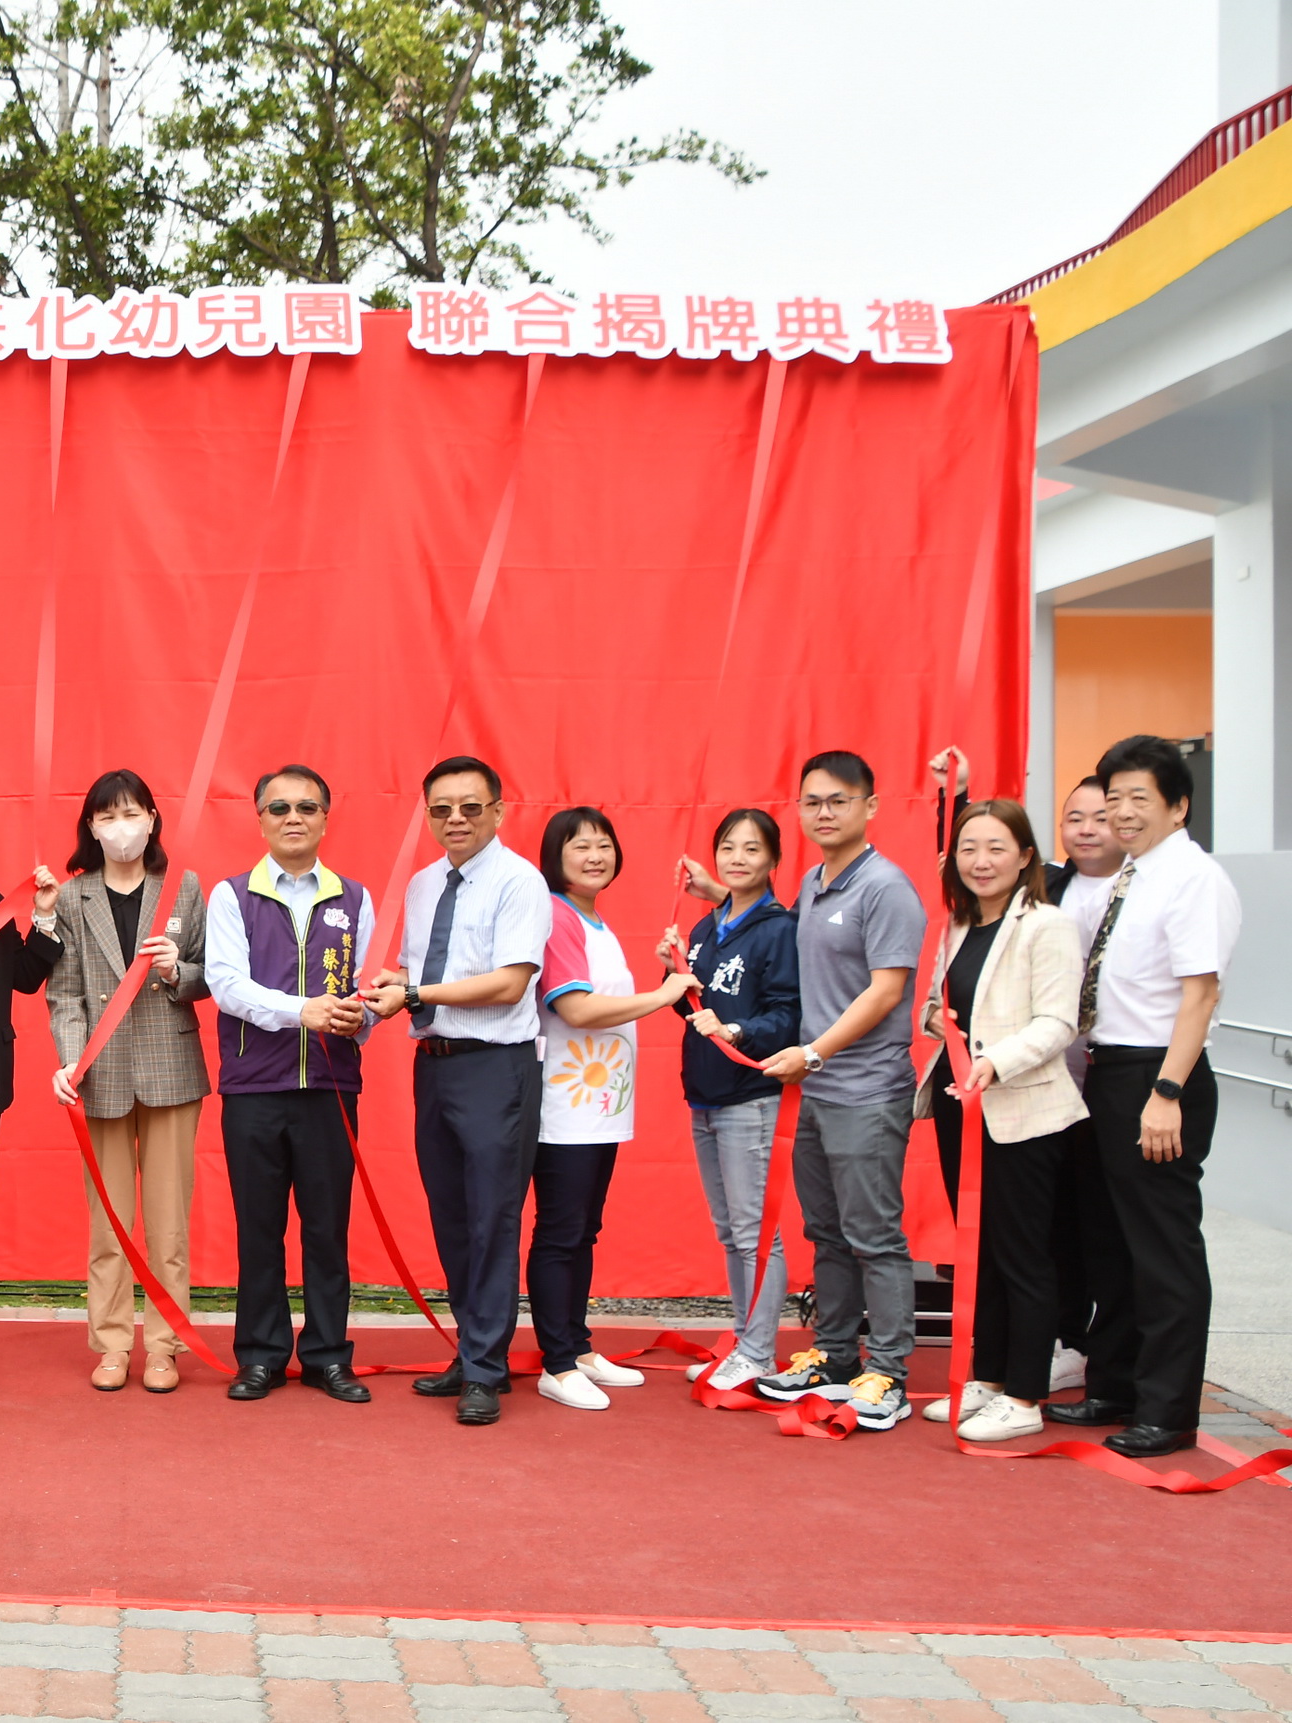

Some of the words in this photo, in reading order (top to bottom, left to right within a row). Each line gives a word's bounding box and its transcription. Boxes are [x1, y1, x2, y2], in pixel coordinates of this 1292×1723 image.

[415, 290, 944, 355] 聯合揭牌典禮
